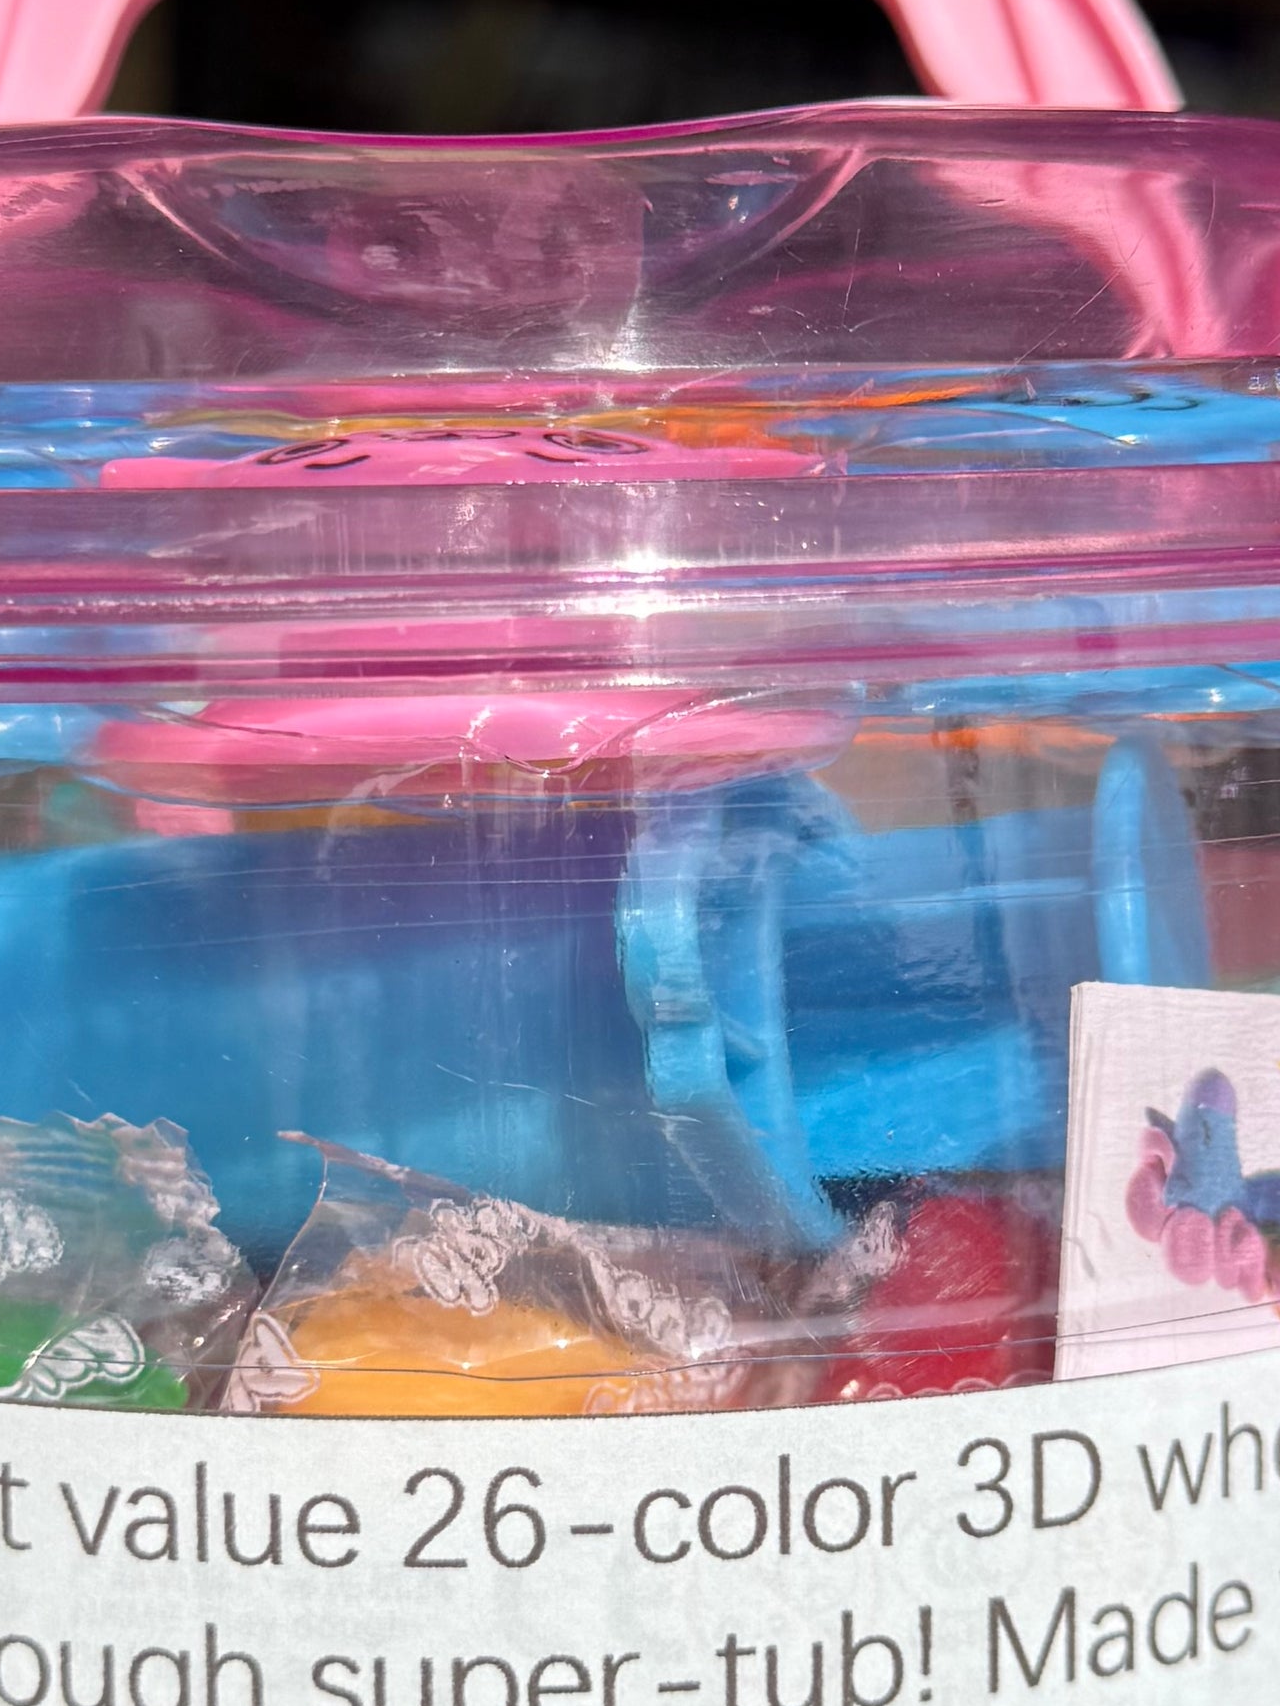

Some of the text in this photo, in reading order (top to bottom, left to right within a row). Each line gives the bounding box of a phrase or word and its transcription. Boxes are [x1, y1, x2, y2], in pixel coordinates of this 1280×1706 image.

[58, 1460, 362, 1571] value
[401, 1453, 918, 1571] 26-color
[955, 1428, 1104, 1541] 3D
[986, 1561, 1256, 1696] Made
